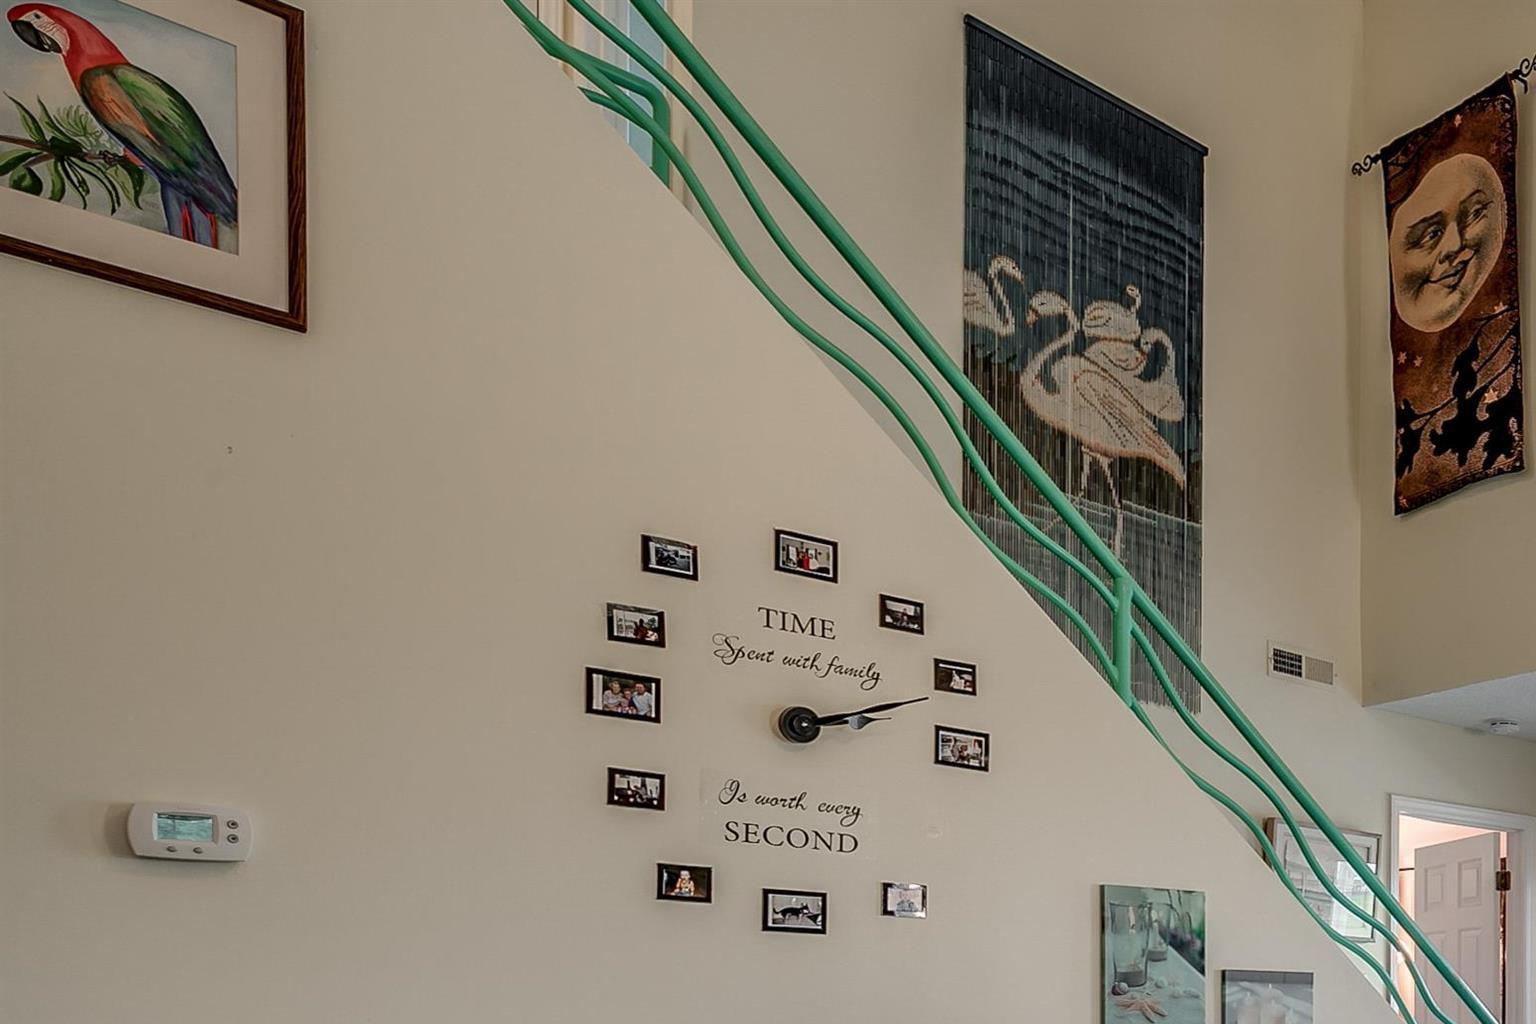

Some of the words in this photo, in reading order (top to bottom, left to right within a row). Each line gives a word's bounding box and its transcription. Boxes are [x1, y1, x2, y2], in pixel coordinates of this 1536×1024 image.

[758, 606, 836, 640] TIME
[712, 633, 775, 666] Spent
[782, 652, 822, 672] with
[815, 655, 883, 691] family
[719, 779, 748, 805] Is
[755, 792, 807, 811] worth
[818, 802, 863, 827] every
[724, 821, 859, 853] SECOND
